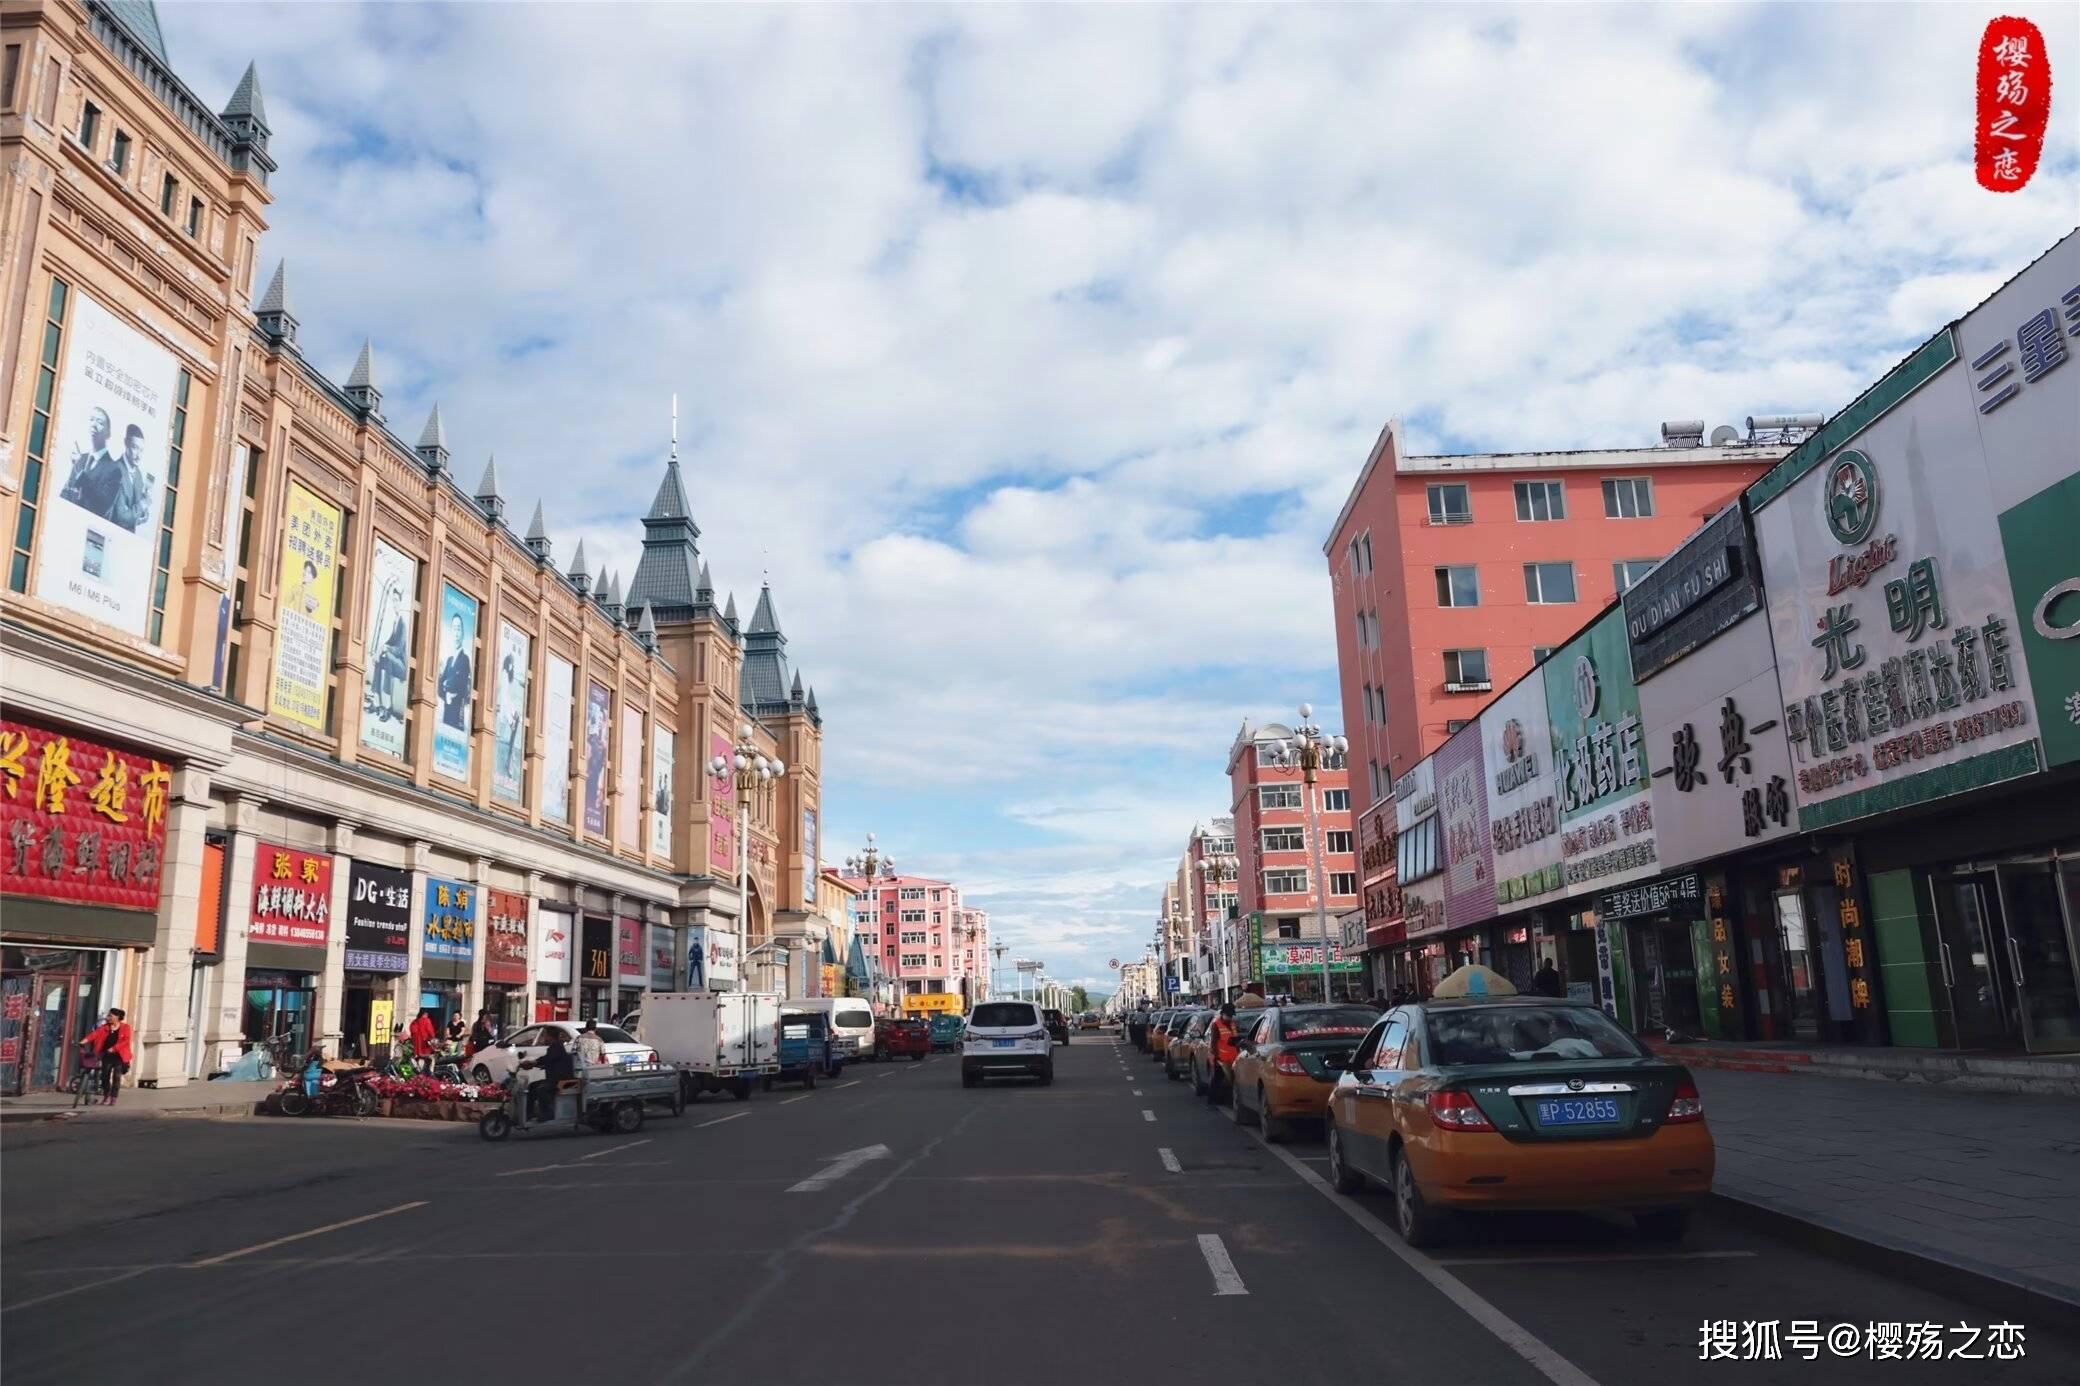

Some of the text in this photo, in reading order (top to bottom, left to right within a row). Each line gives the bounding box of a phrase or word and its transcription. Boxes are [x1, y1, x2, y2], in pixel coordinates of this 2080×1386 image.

[1631, 553, 1728, 639] OU DIAN FU SHI
[1825, 532, 1898, 597] Light
[1811, 556, 1949, 682] 光明
[0, 730, 171, 840] 兴隆超市
[1742, 774, 1790, 837] 服饰
[271, 852, 320, 884] 张家
[256, 883, 329, 925] 海鲜调料大全
[1168, 978, 1176, 990] P
